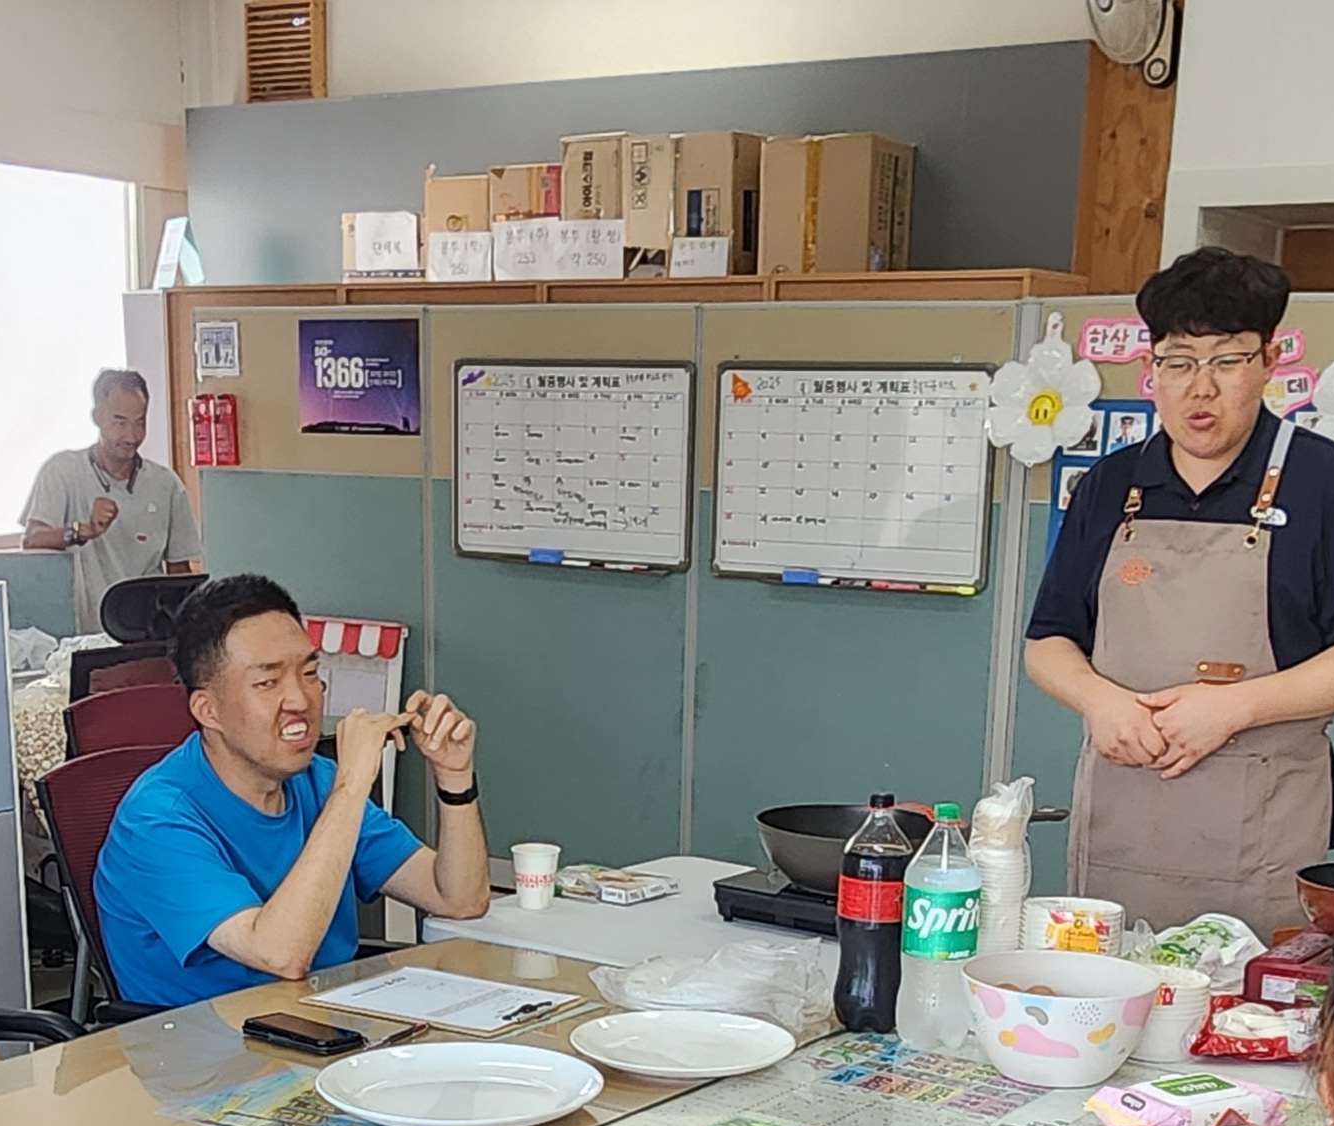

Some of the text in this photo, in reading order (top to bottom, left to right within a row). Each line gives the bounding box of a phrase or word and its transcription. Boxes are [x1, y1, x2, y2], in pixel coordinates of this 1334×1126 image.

[1088, 327, 1131, 355] 한살
[314, 357, 364, 388] 1366
[813, 380, 858, 394] 월중행사
